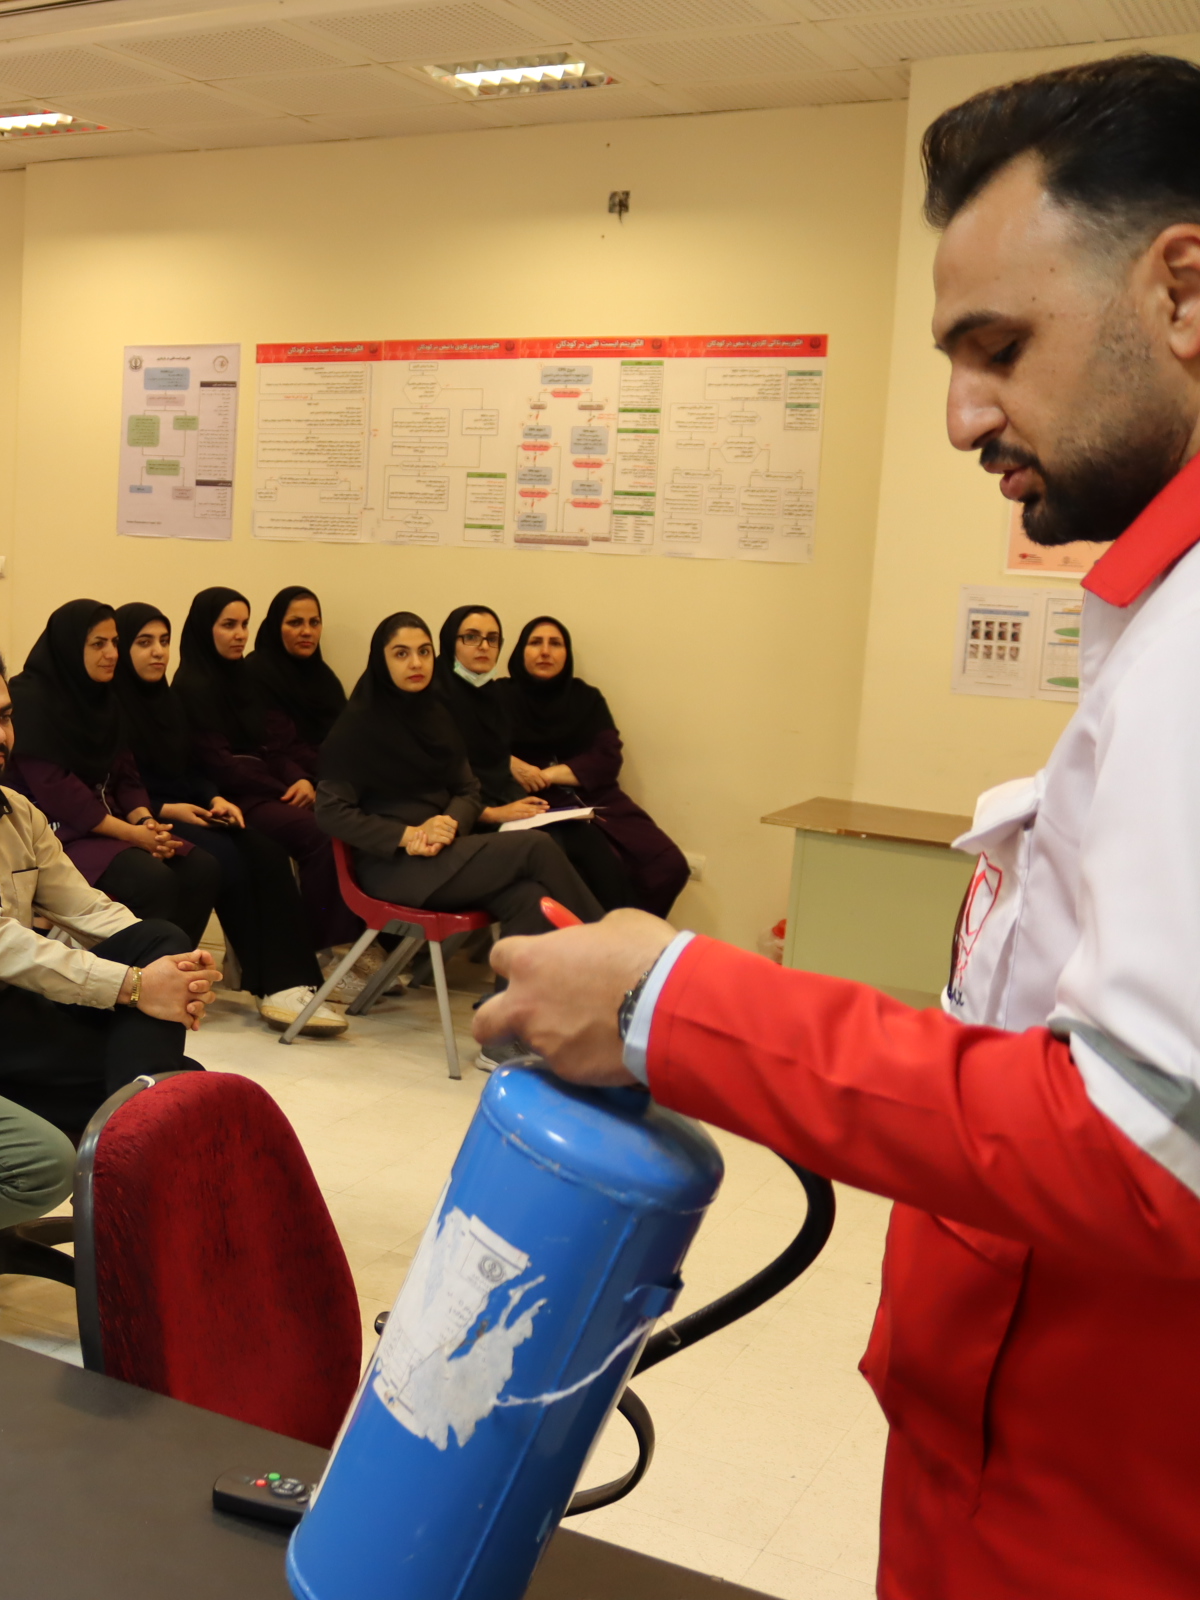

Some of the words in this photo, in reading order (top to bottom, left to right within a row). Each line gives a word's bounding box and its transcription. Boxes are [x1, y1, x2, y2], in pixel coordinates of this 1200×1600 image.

[556, 340, 576, 348] کودکان
[586, 340, 600, 348] قلبی
[620, 339, 644, 348] الگوریتم
